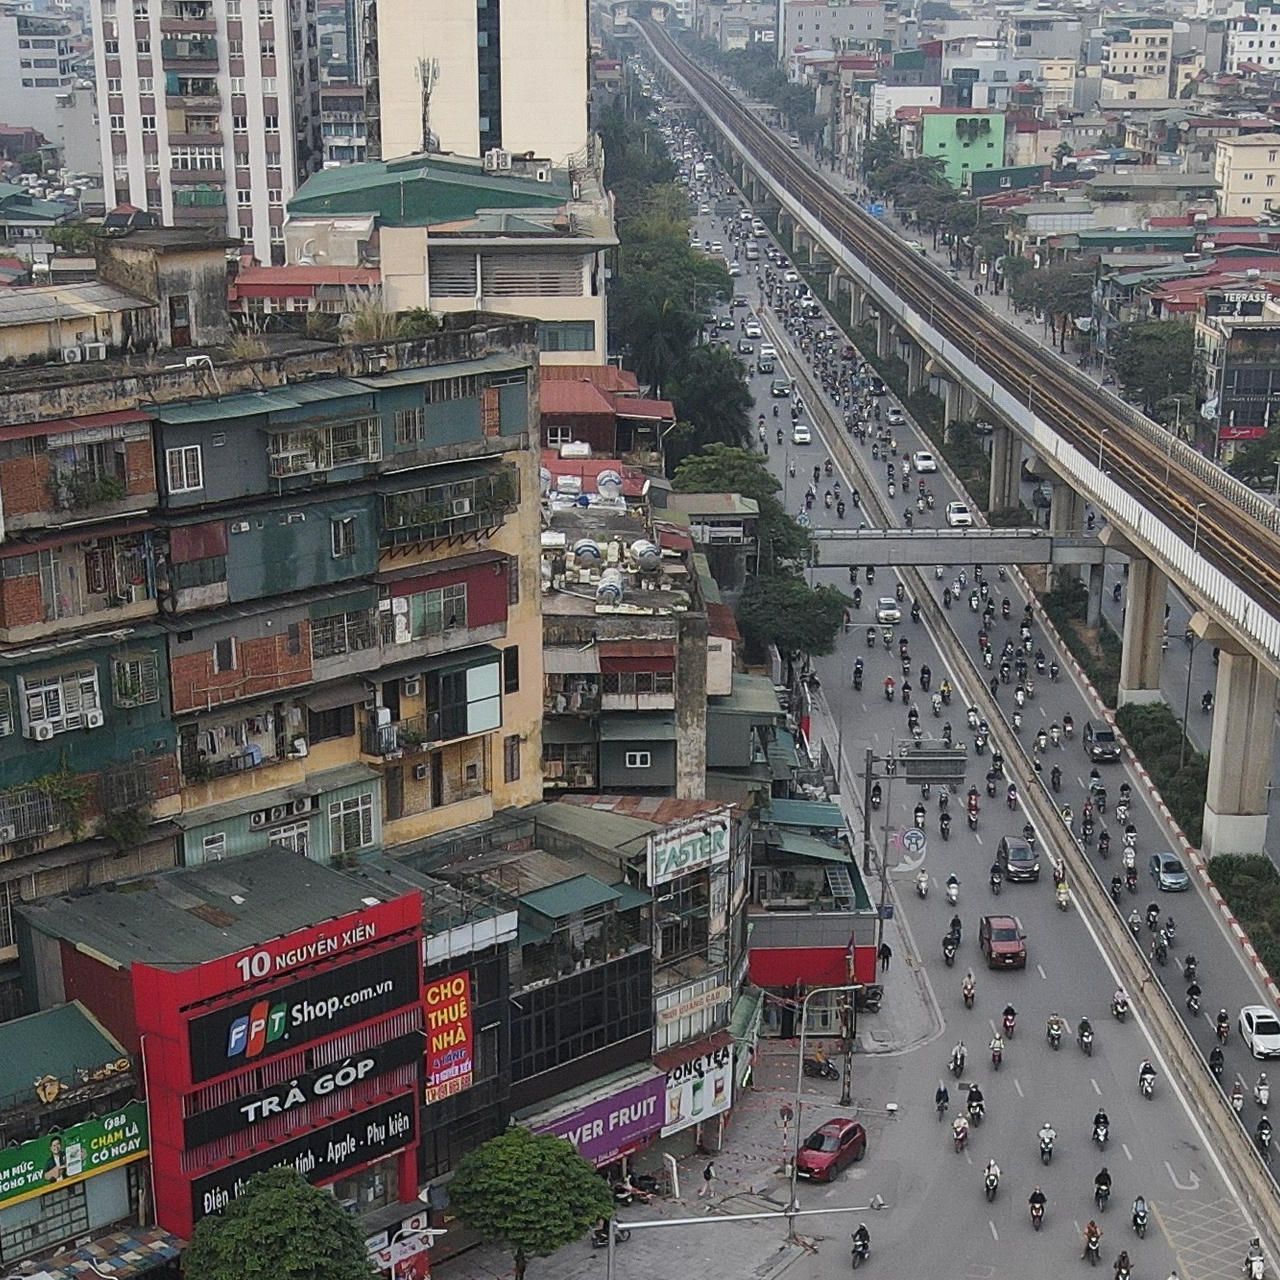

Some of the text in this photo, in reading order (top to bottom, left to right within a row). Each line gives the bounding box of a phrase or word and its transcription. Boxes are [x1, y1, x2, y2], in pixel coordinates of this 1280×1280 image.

[1224, 293, 1272, 303] TERRASSE
[655, 829, 727, 875] FASTER
[236, 919, 376, 982] 10 NGUYỄN XIỂN
[426, 978, 465, 1005] CHO
[229, 979, 394, 1055] FPT Shop.com.vn
[428, 996, 469, 1030] THUÊ
[431, 1022, 467, 1053] NHÀ
[240, 1059, 376, 1123] TRẢ GÓP
[608, 1096, 657, 1133] FRUIT
[90, 1130, 124, 1150] CHẠM
[91, 1136, 142, 1164] CÓ NGAY
[327, 1132, 357, 1166] Apple
[366, 1121, 386, 1147] Phụ
[388, 1111, 411, 1140] kiện
[27, 1168, 45, 1184] TAY
